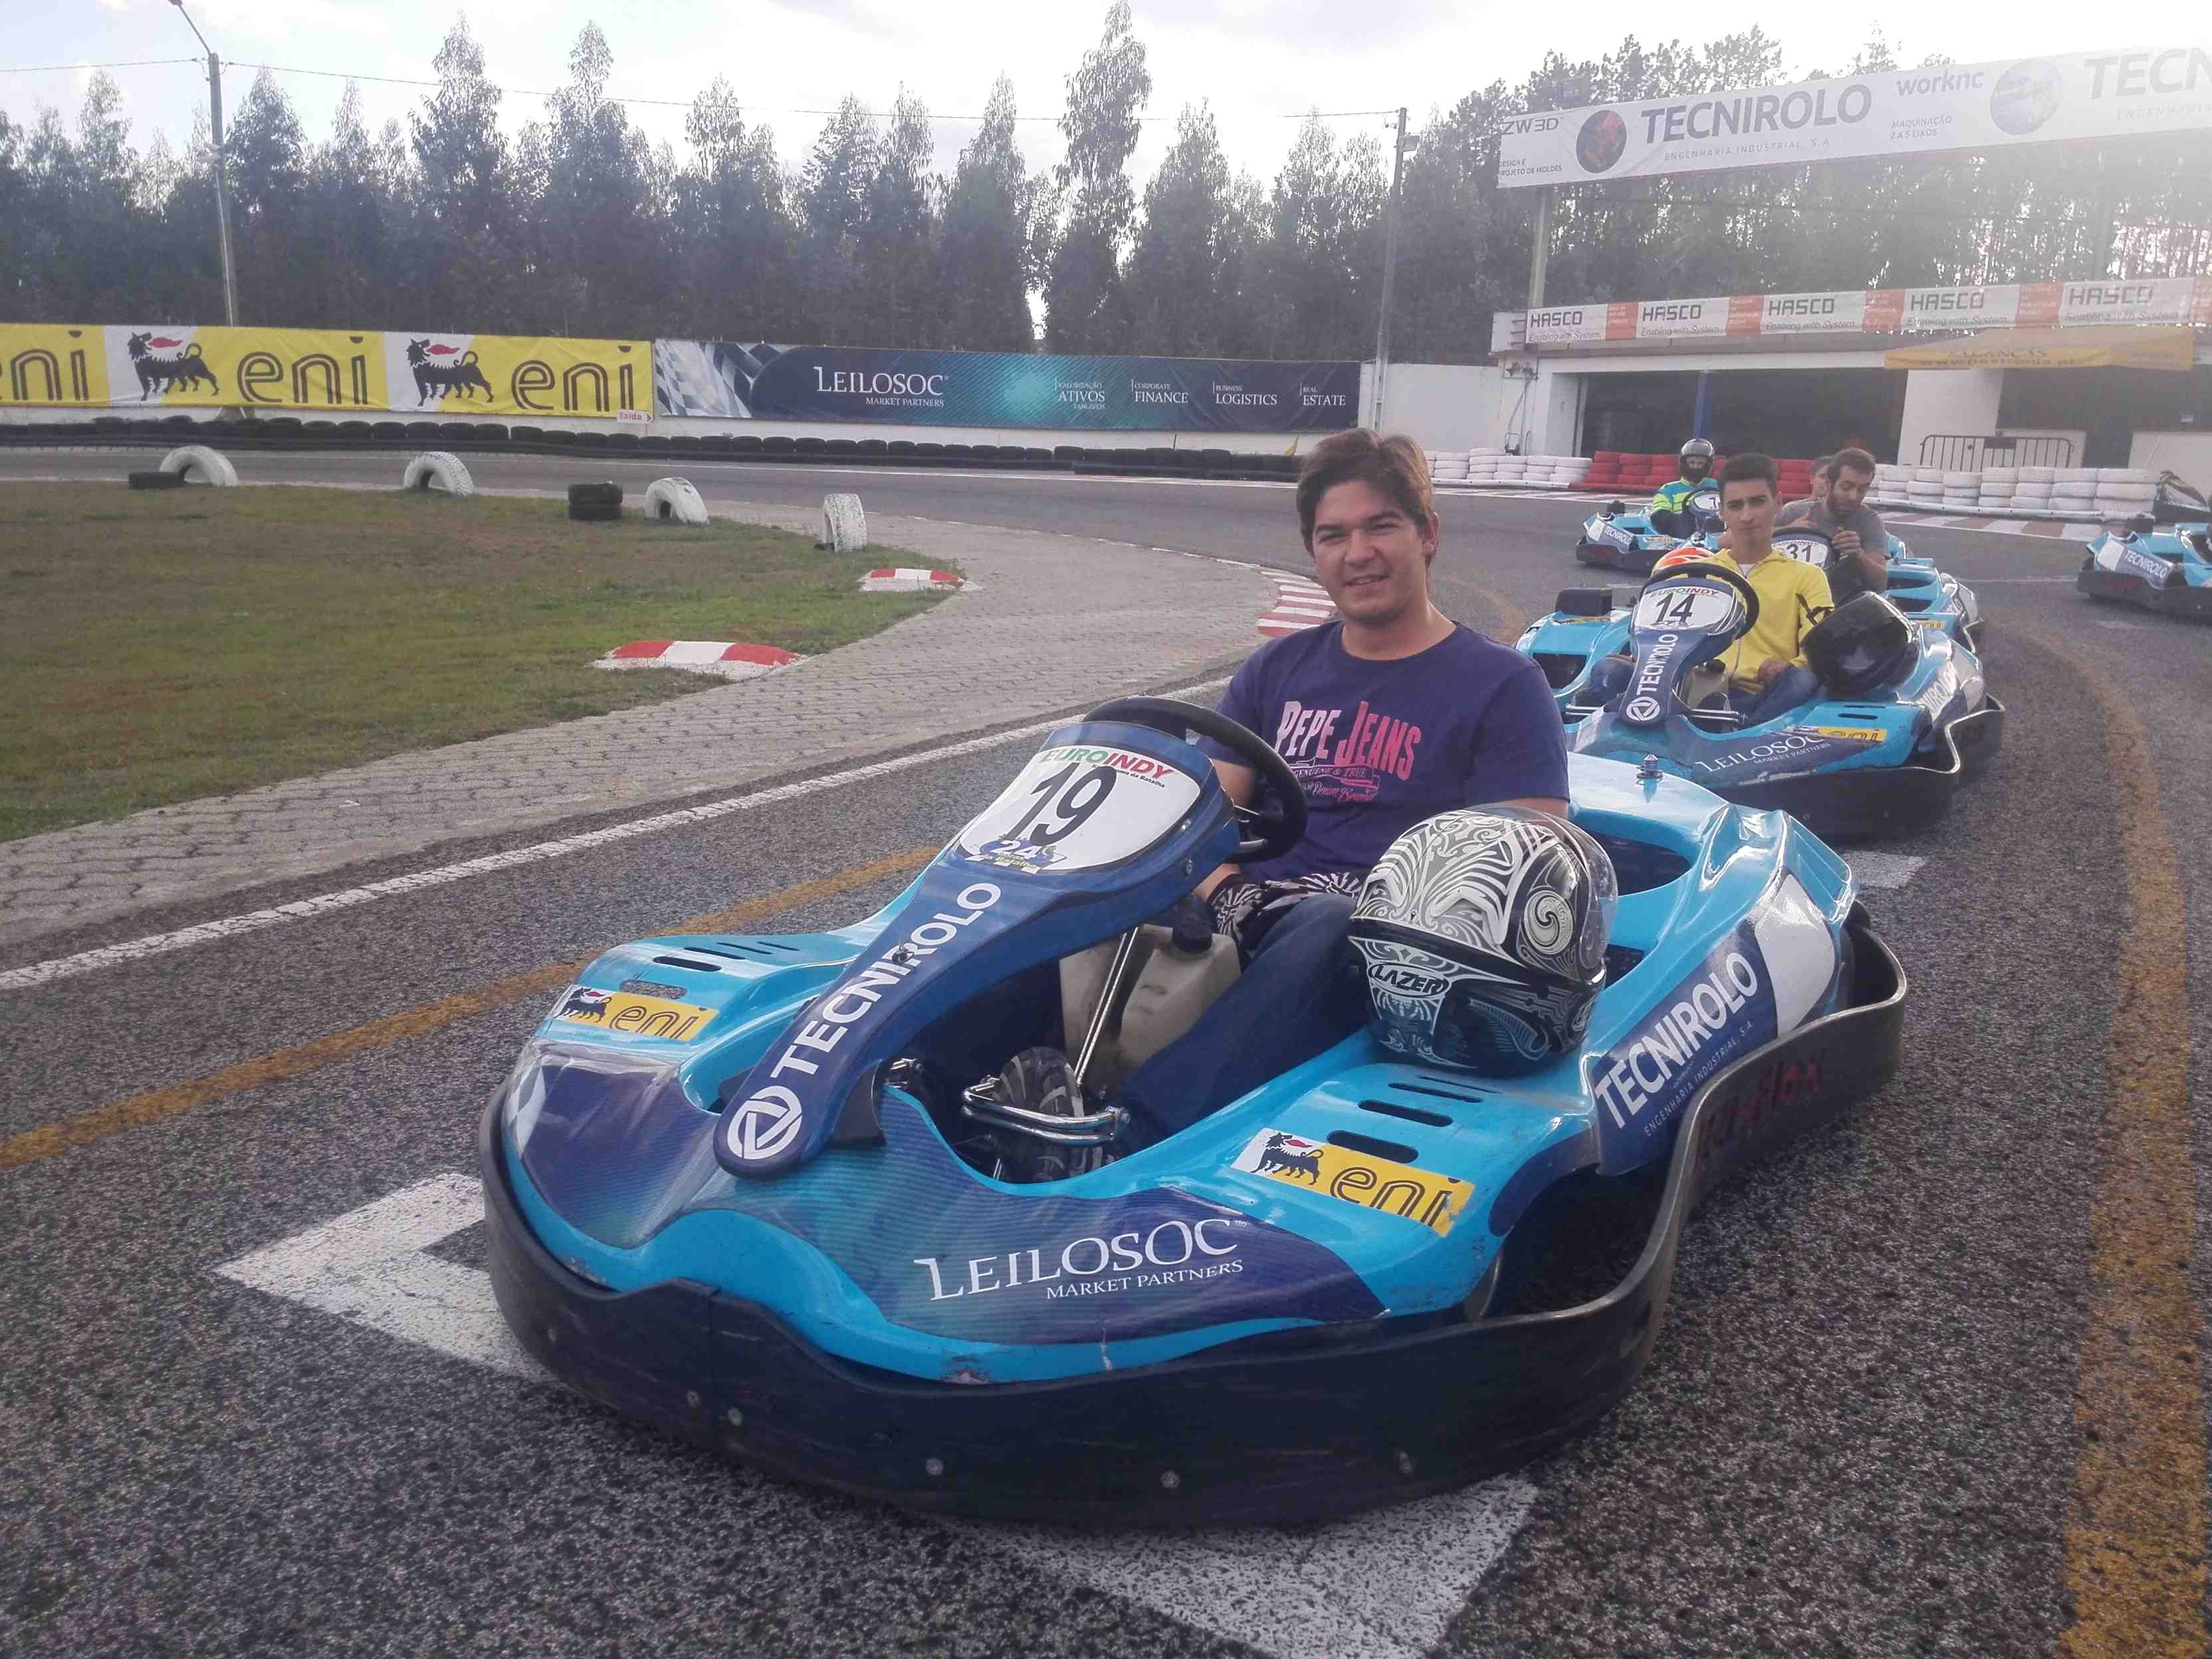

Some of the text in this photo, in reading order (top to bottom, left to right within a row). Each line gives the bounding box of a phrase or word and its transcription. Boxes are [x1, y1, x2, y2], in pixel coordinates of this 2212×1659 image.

[1896, 70, 1984, 96] worknc
[1641, 84, 1872, 144] TECNIROLO
[1769, 298, 1835, 316] HASCO
[1910, 292, 1984, 311] HASCO
[2069, 286, 2153, 305] HASCO
[1530, 311, 1582, 327] HASCO
[1642, 304, 1702, 322] HASCO
[0, 330, 89, 401] ni
[237, 336, 368, 405] eni
[511, 345, 634, 412] eni
[812, 366, 944, 396] LEILOSOC
[1057, 390, 1105, 402] ATIVOS
[865, 397, 944, 407] MARKET PARTNERS
[1135, 392, 1188, 403] FINANCE
[1215, 393, 1277, 405] LOGISTICS
[1303, 395, 1346, 406] ESTATE
[1786, 544, 1812, 562] 31
[2125, 549, 2167, 578] TECNIROLO
[1654, 594, 1696, 626] 14
[1275, 701, 1422, 781] PEPE JEANS
[1041, 748, 1176, 778] EUROINDY
[1030, 762, 1118, 846] 19
[990, 839, 1043, 860] 24
[770, 883, 1002, 1079] TECNIROLO
[1374, 965, 1449, 995] LAZER
[609, 1006, 708, 1040] eni
[1595, 952, 1758, 1129] TECNIROLO
[1644, 1081, 1694, 1137] ENGENHARIA
[1330, 1166, 1462, 1228] eni
[914, 1219, 1238, 1301] LEILOSOC
[1047, 1259, 1244, 1299] MARKET PARTNERS
